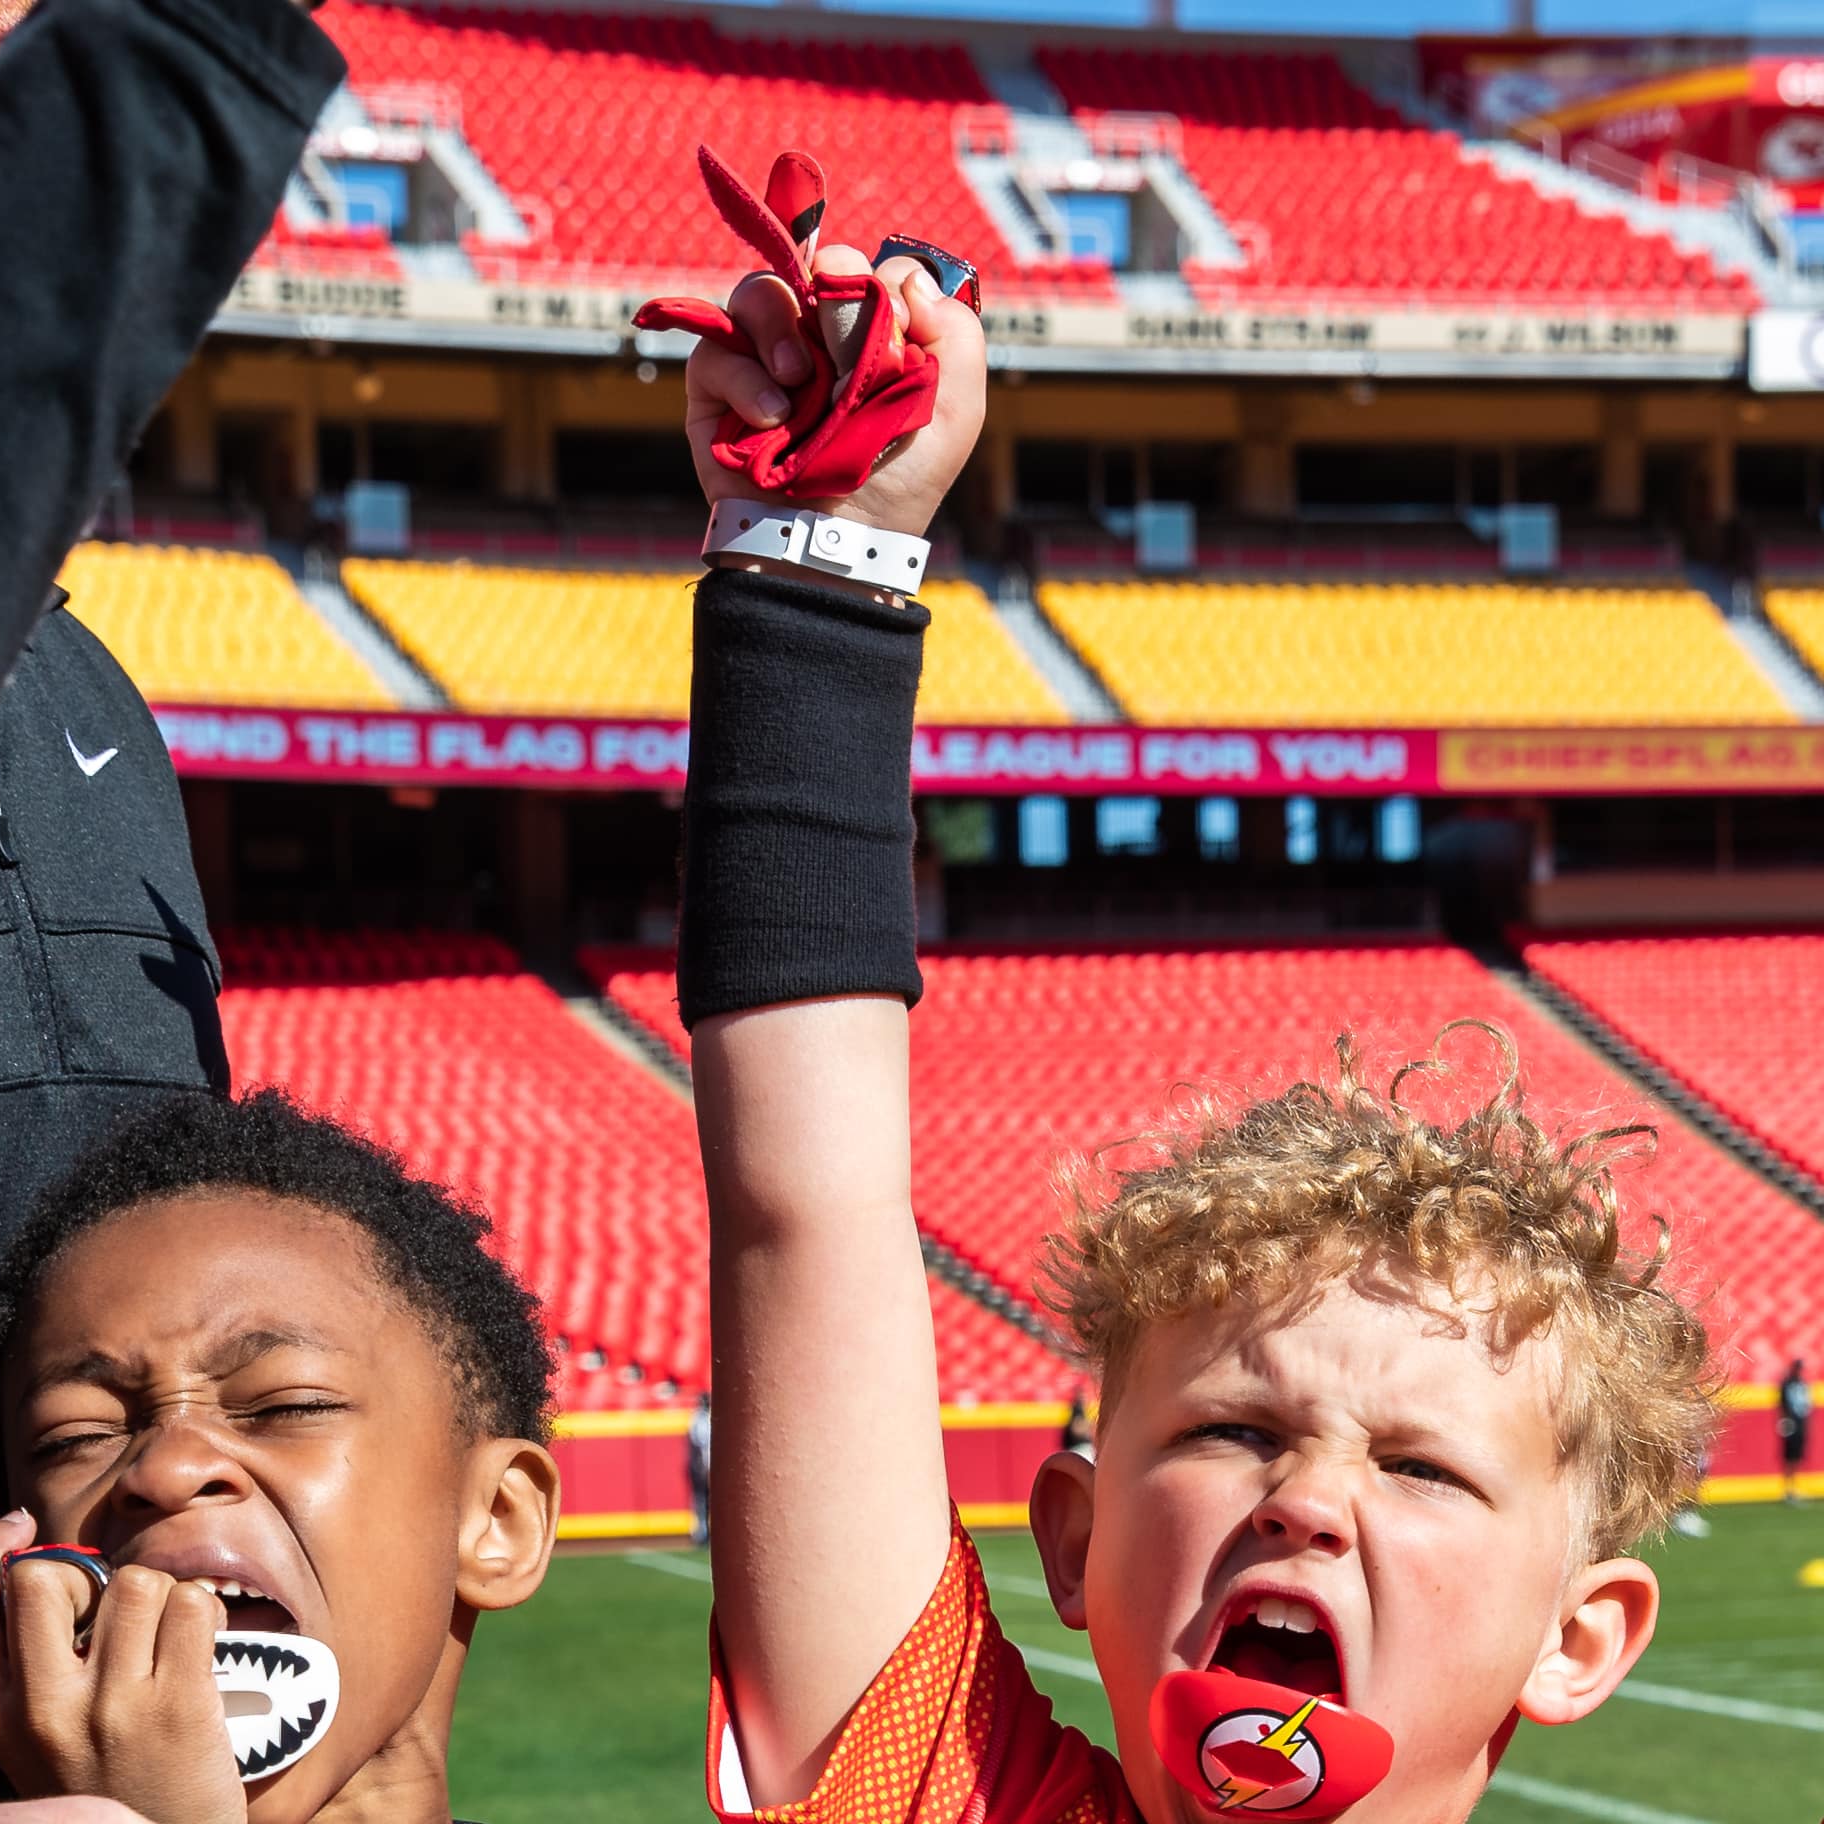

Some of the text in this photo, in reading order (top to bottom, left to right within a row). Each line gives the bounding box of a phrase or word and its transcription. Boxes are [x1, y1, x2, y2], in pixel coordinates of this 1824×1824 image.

[158, 710, 287, 762] FIND
[300, 718, 420, 766] THE
[429, 722, 584, 772] FLAG
[913, 733, 1407, 780] LEAGUE FOR YOU!
